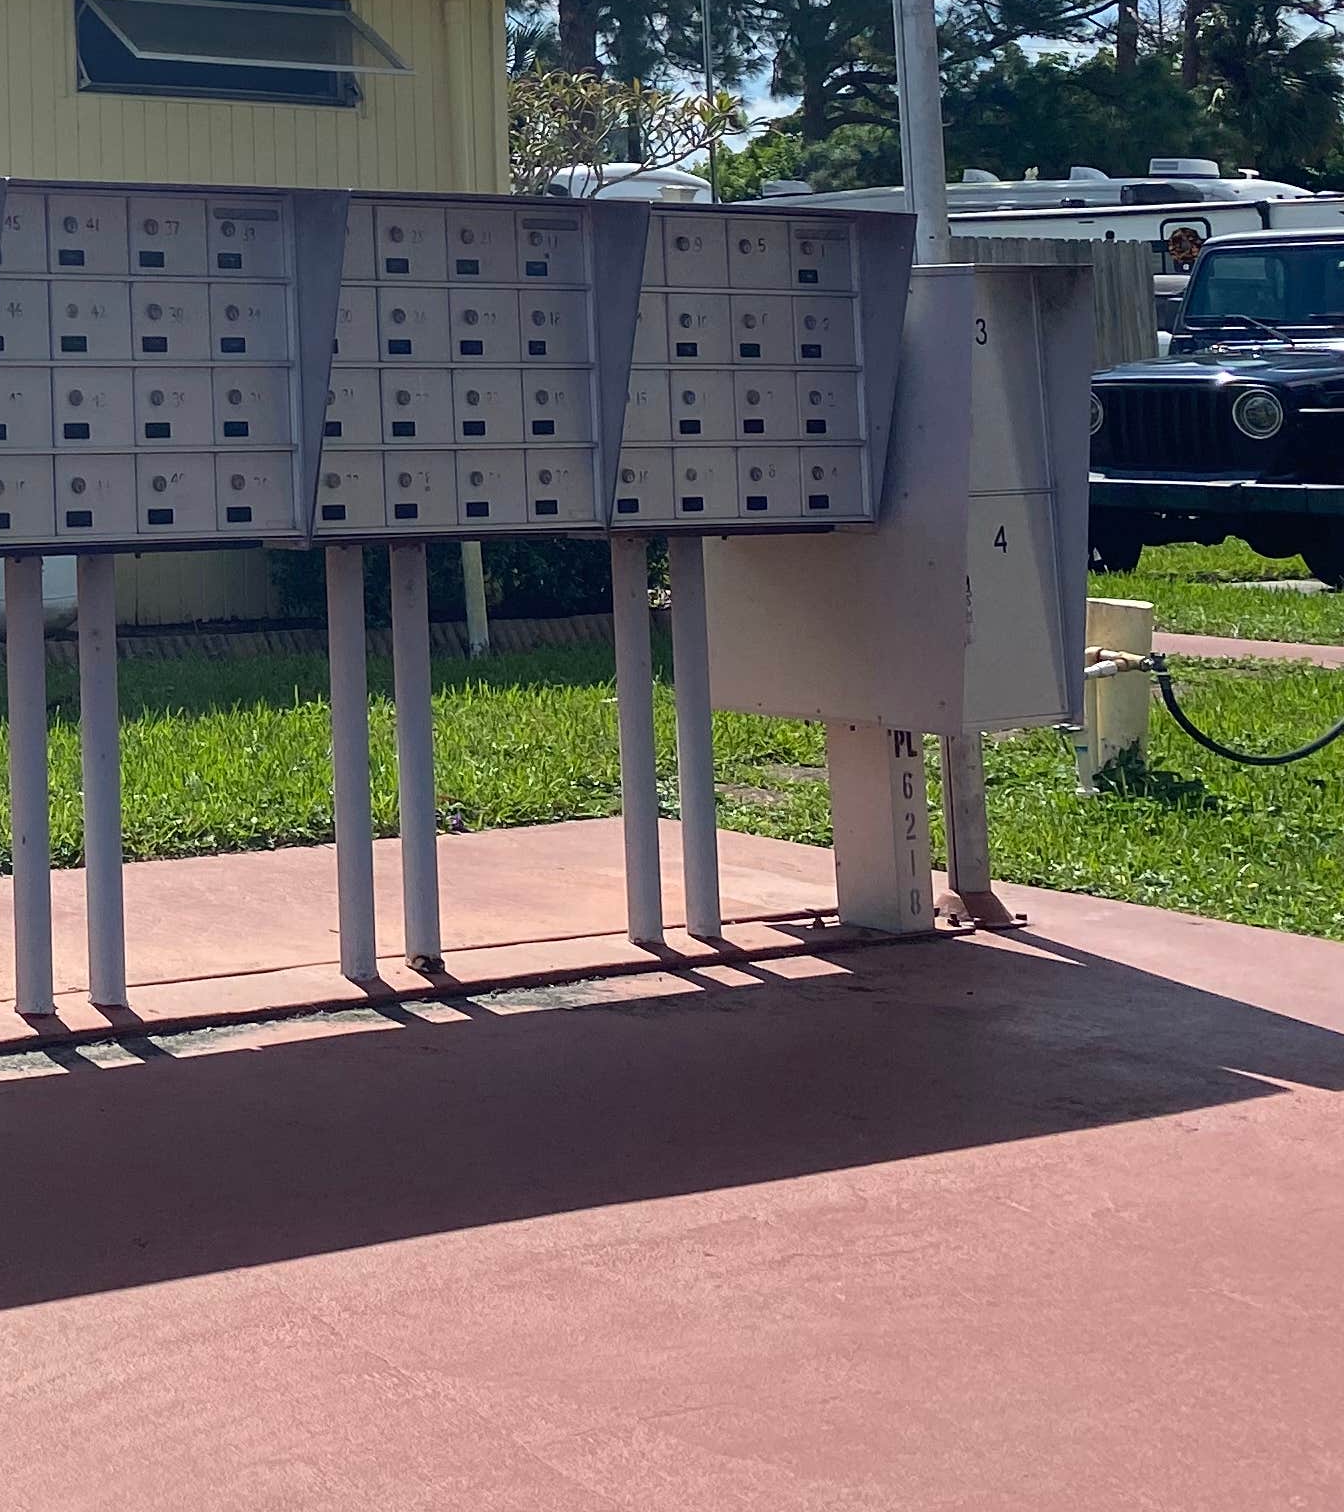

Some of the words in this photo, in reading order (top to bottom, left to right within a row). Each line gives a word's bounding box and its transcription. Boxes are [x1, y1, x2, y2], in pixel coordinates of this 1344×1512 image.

[758, 237, 767, 253] 5
[975, 317, 988, 345] 3
[994, 524, 1007, 554] 4
[894, 729, 917, 758] PL
